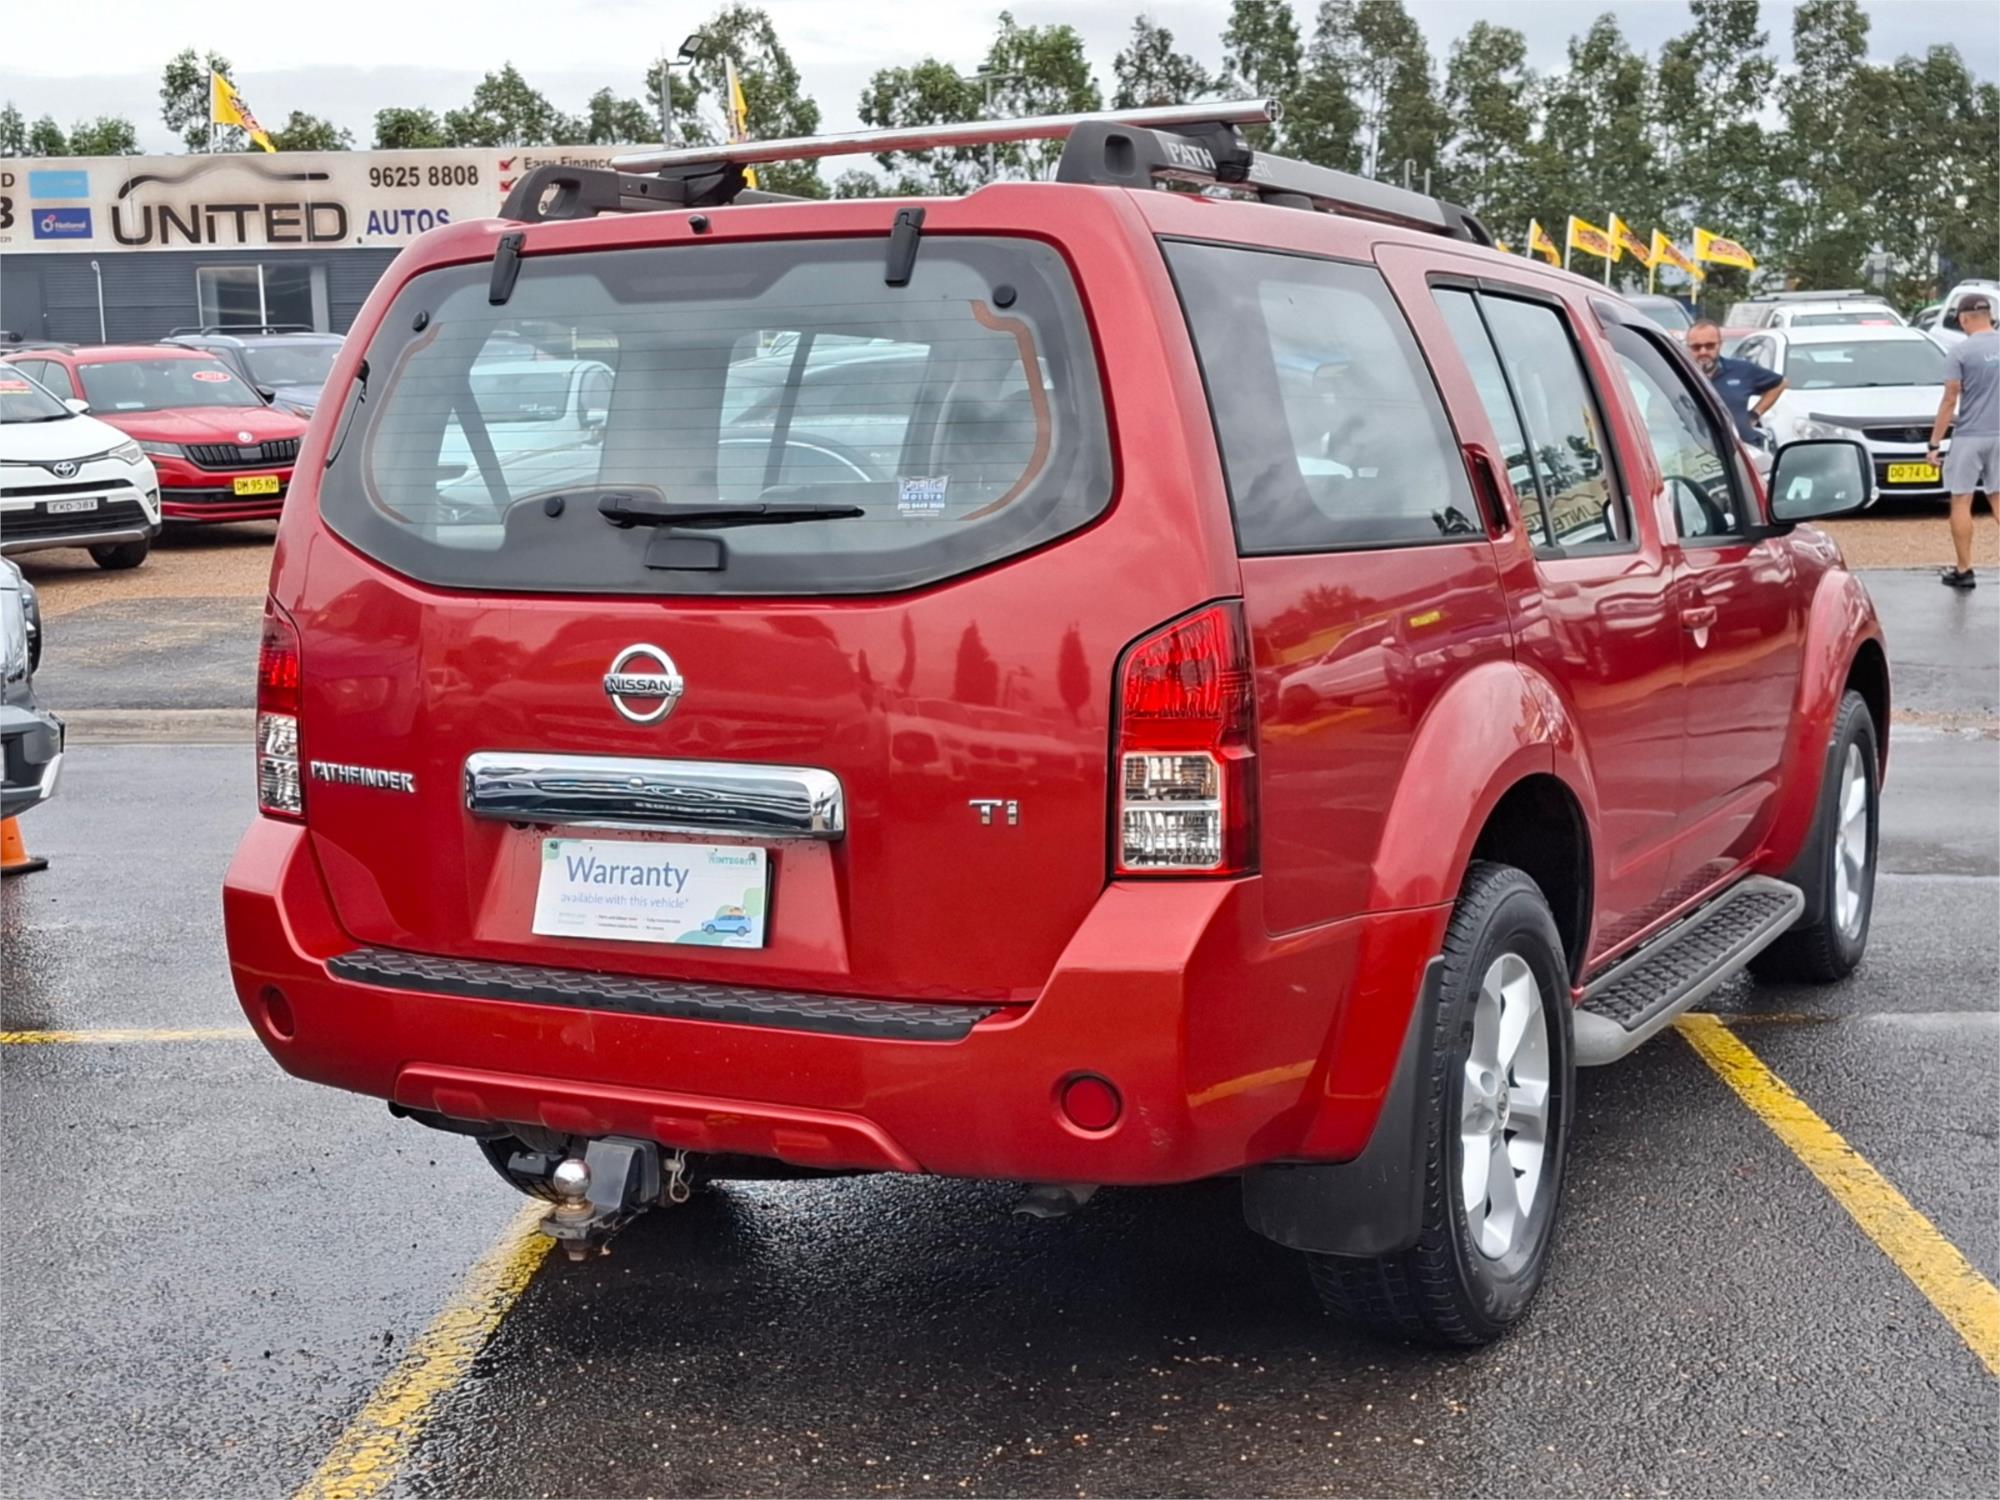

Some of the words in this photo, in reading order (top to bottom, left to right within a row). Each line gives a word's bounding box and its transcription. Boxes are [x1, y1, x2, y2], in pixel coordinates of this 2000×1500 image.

[369, 166, 420, 188] 9625
[428, 165, 479, 186] 8808
[367, 208, 450, 235] AUTOS
[608, 675, 672, 693] NISSAN
[310, 760, 416, 794] PATHFINDER
[566, 855, 690, 894] Warranty
[560, 892, 604, 905] available
[605, 894, 628, 907] with
[630, 895, 649, 908] this
